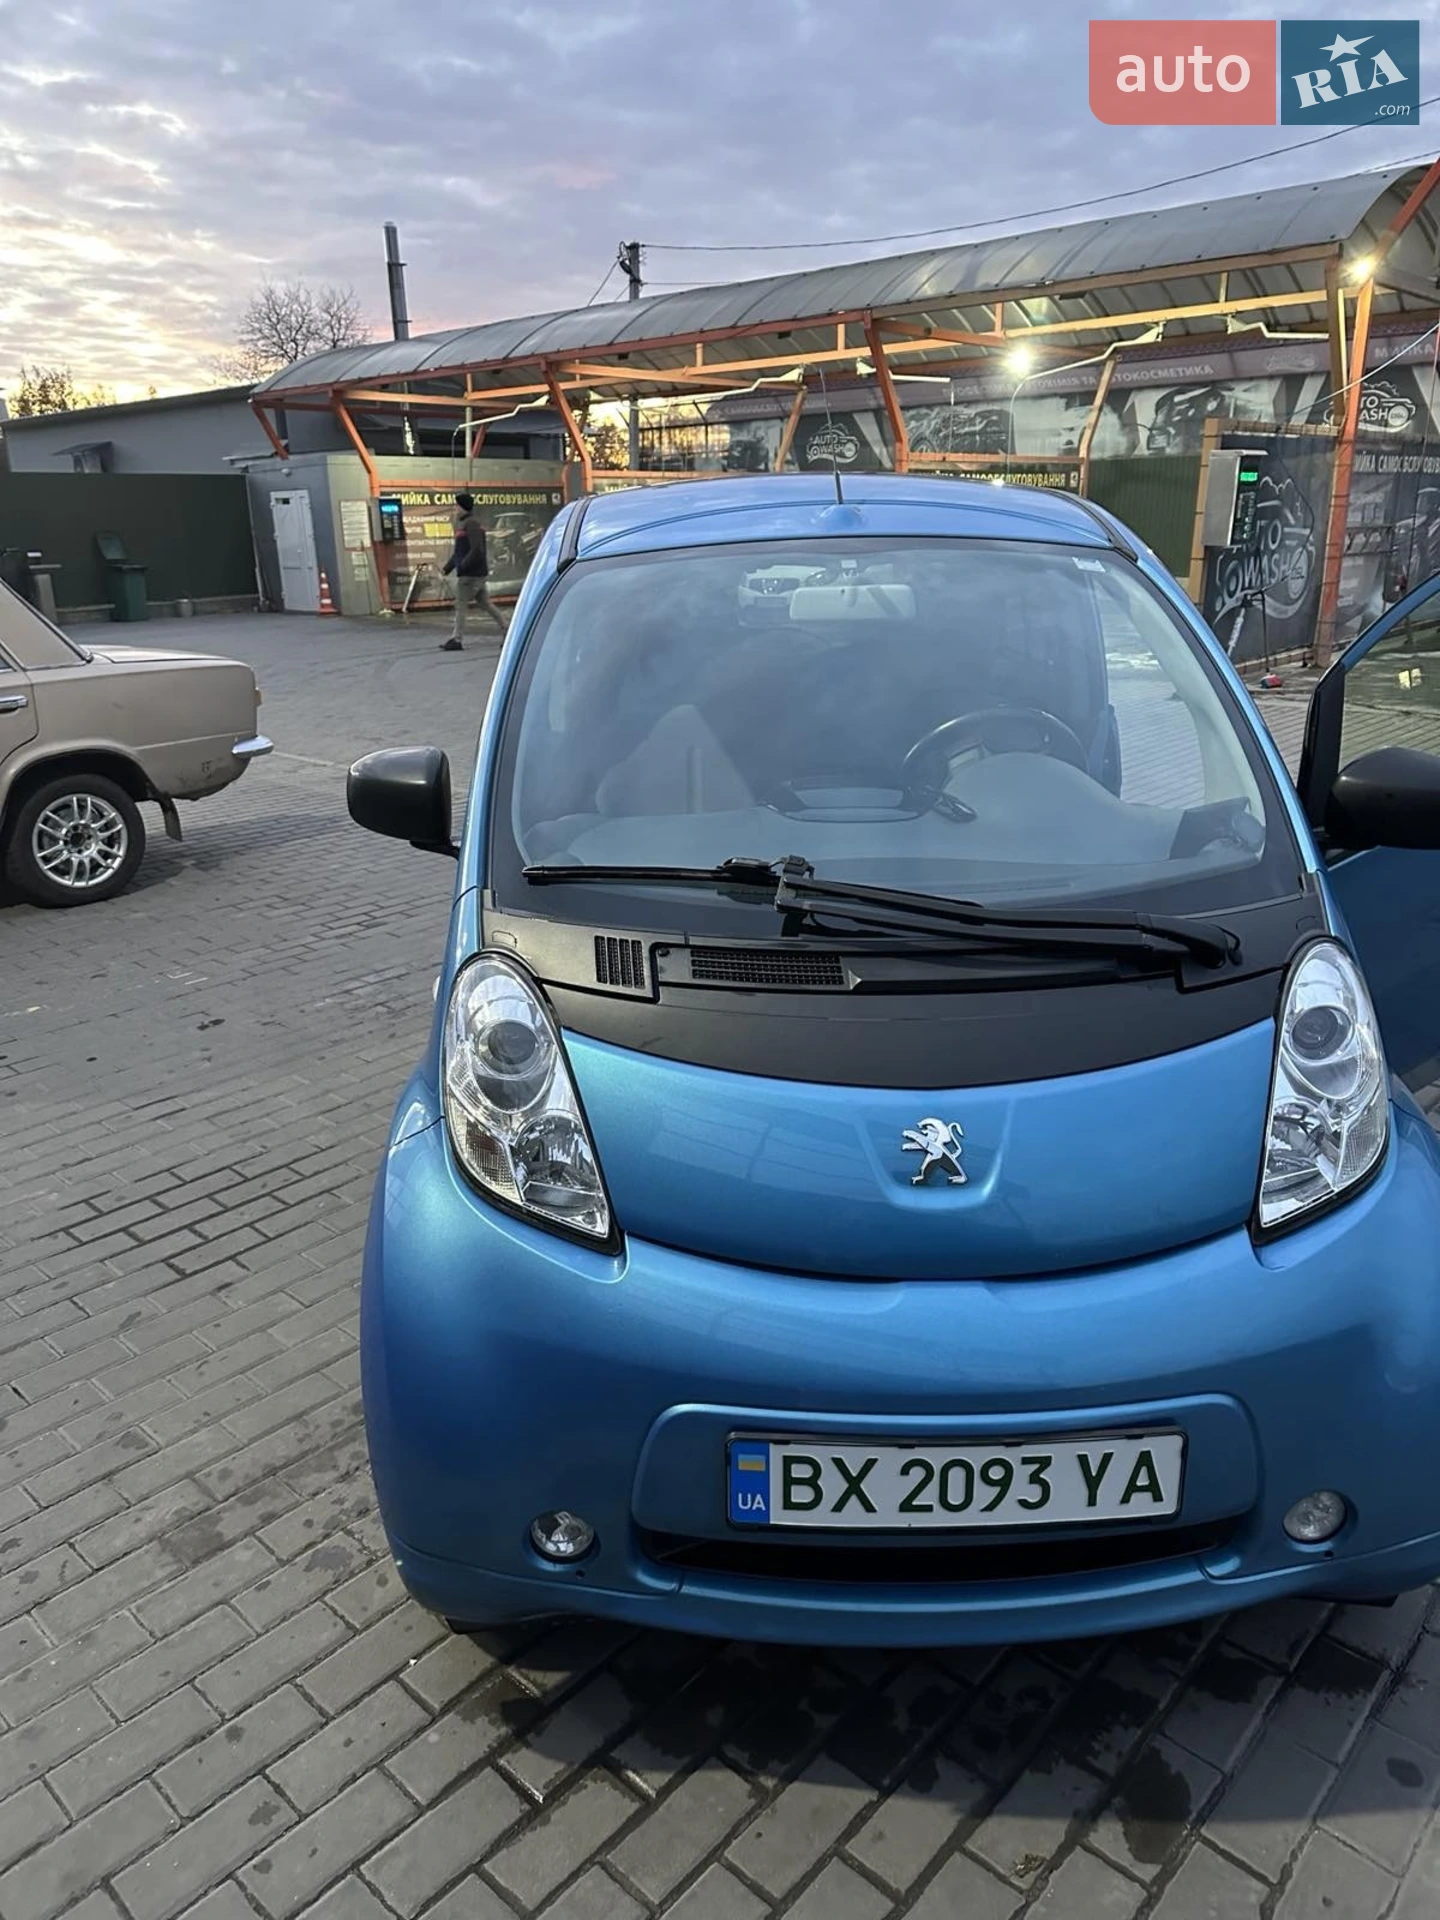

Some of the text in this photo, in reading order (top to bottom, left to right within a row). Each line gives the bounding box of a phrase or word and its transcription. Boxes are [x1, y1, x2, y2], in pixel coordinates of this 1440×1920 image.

[1108, 364, 1215, 384] ТОКОСМЕТИКА
[813, 434, 839, 444] AUTO
[820, 445, 844, 454] WASH
[1243, 550, 1292, 589] WASH
[781, 1449, 1165, 1513] BX 2093 YA
[737, 1493, 766, 1511] UA
